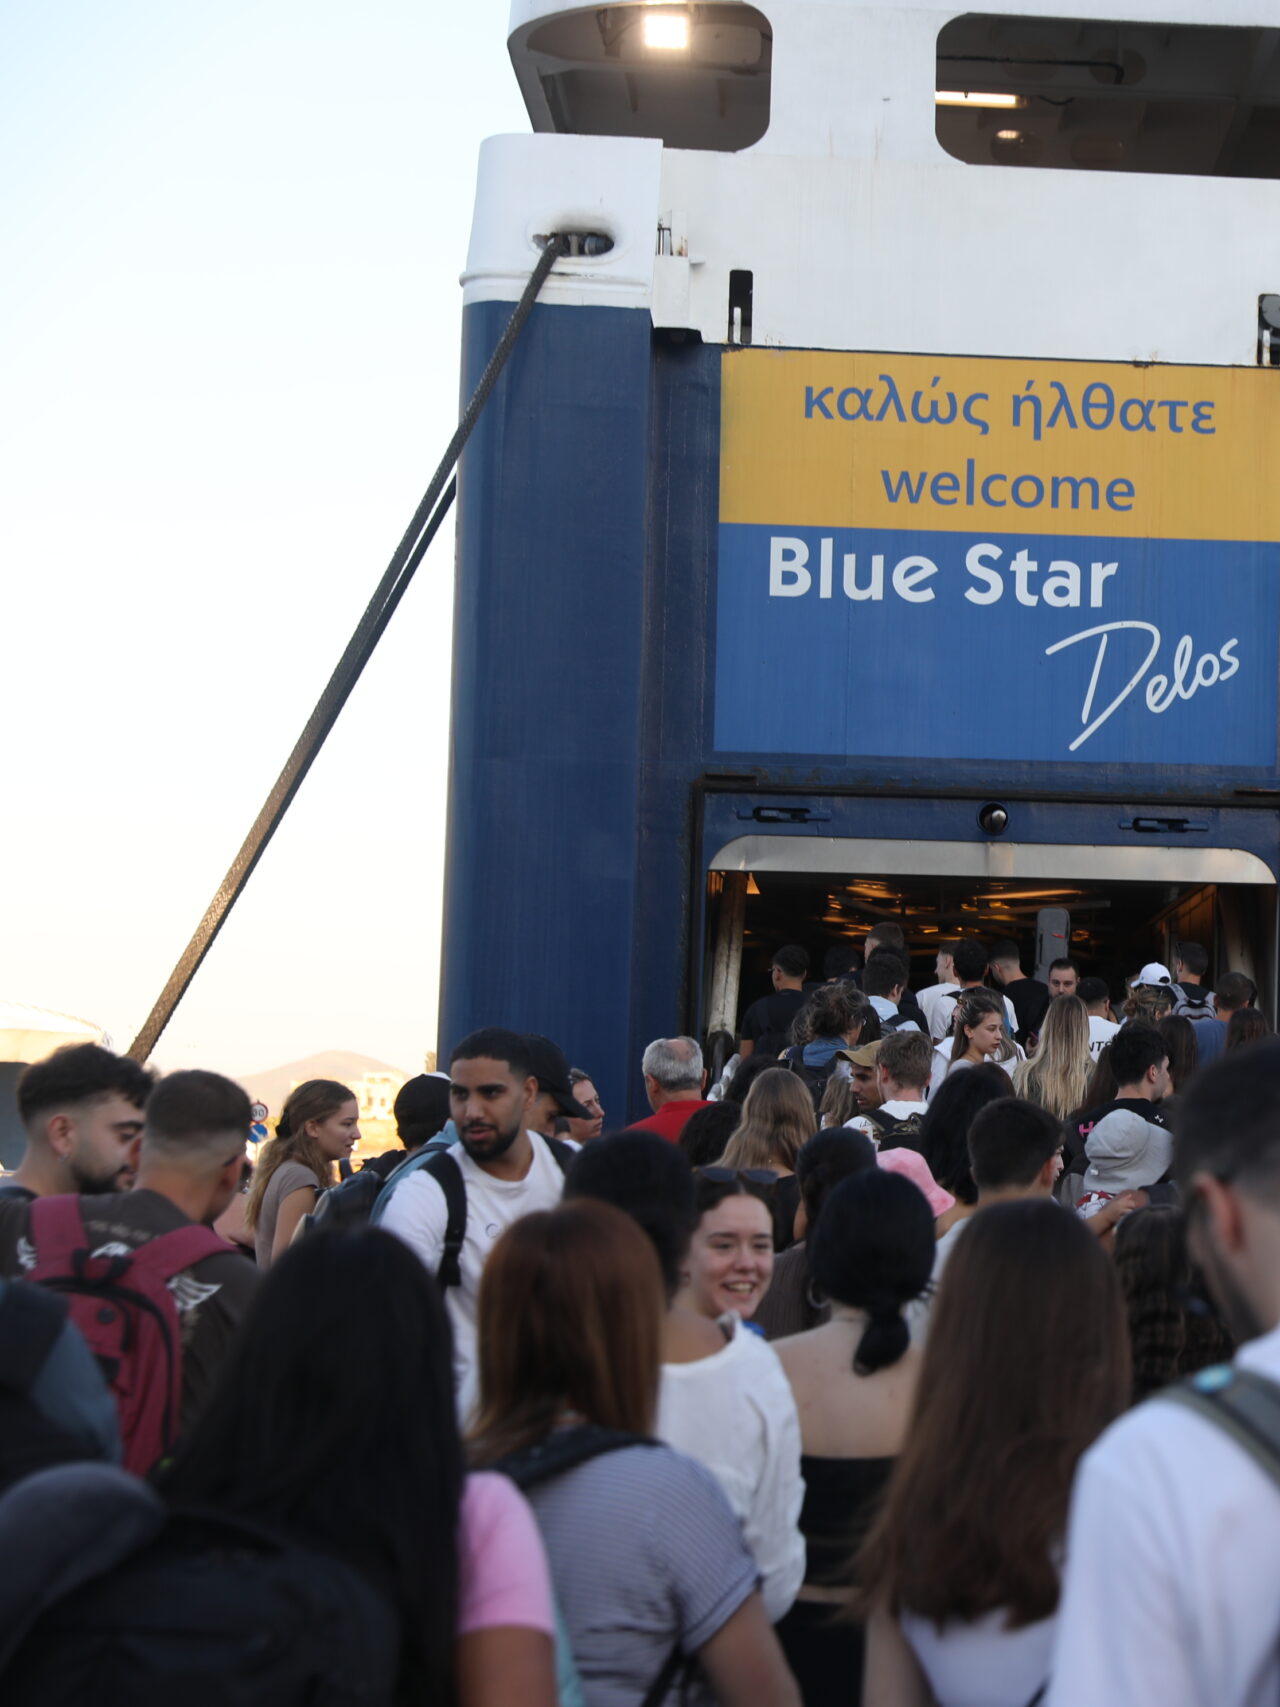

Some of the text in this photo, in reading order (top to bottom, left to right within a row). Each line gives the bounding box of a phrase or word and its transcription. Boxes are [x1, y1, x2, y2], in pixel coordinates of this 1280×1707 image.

[804, 374, 1217, 441] καλώς ήλθατε
[881, 458, 1136, 512] welcome
[768, 536, 1119, 608] Blue Star
[1045, 620, 1240, 752] Delos
